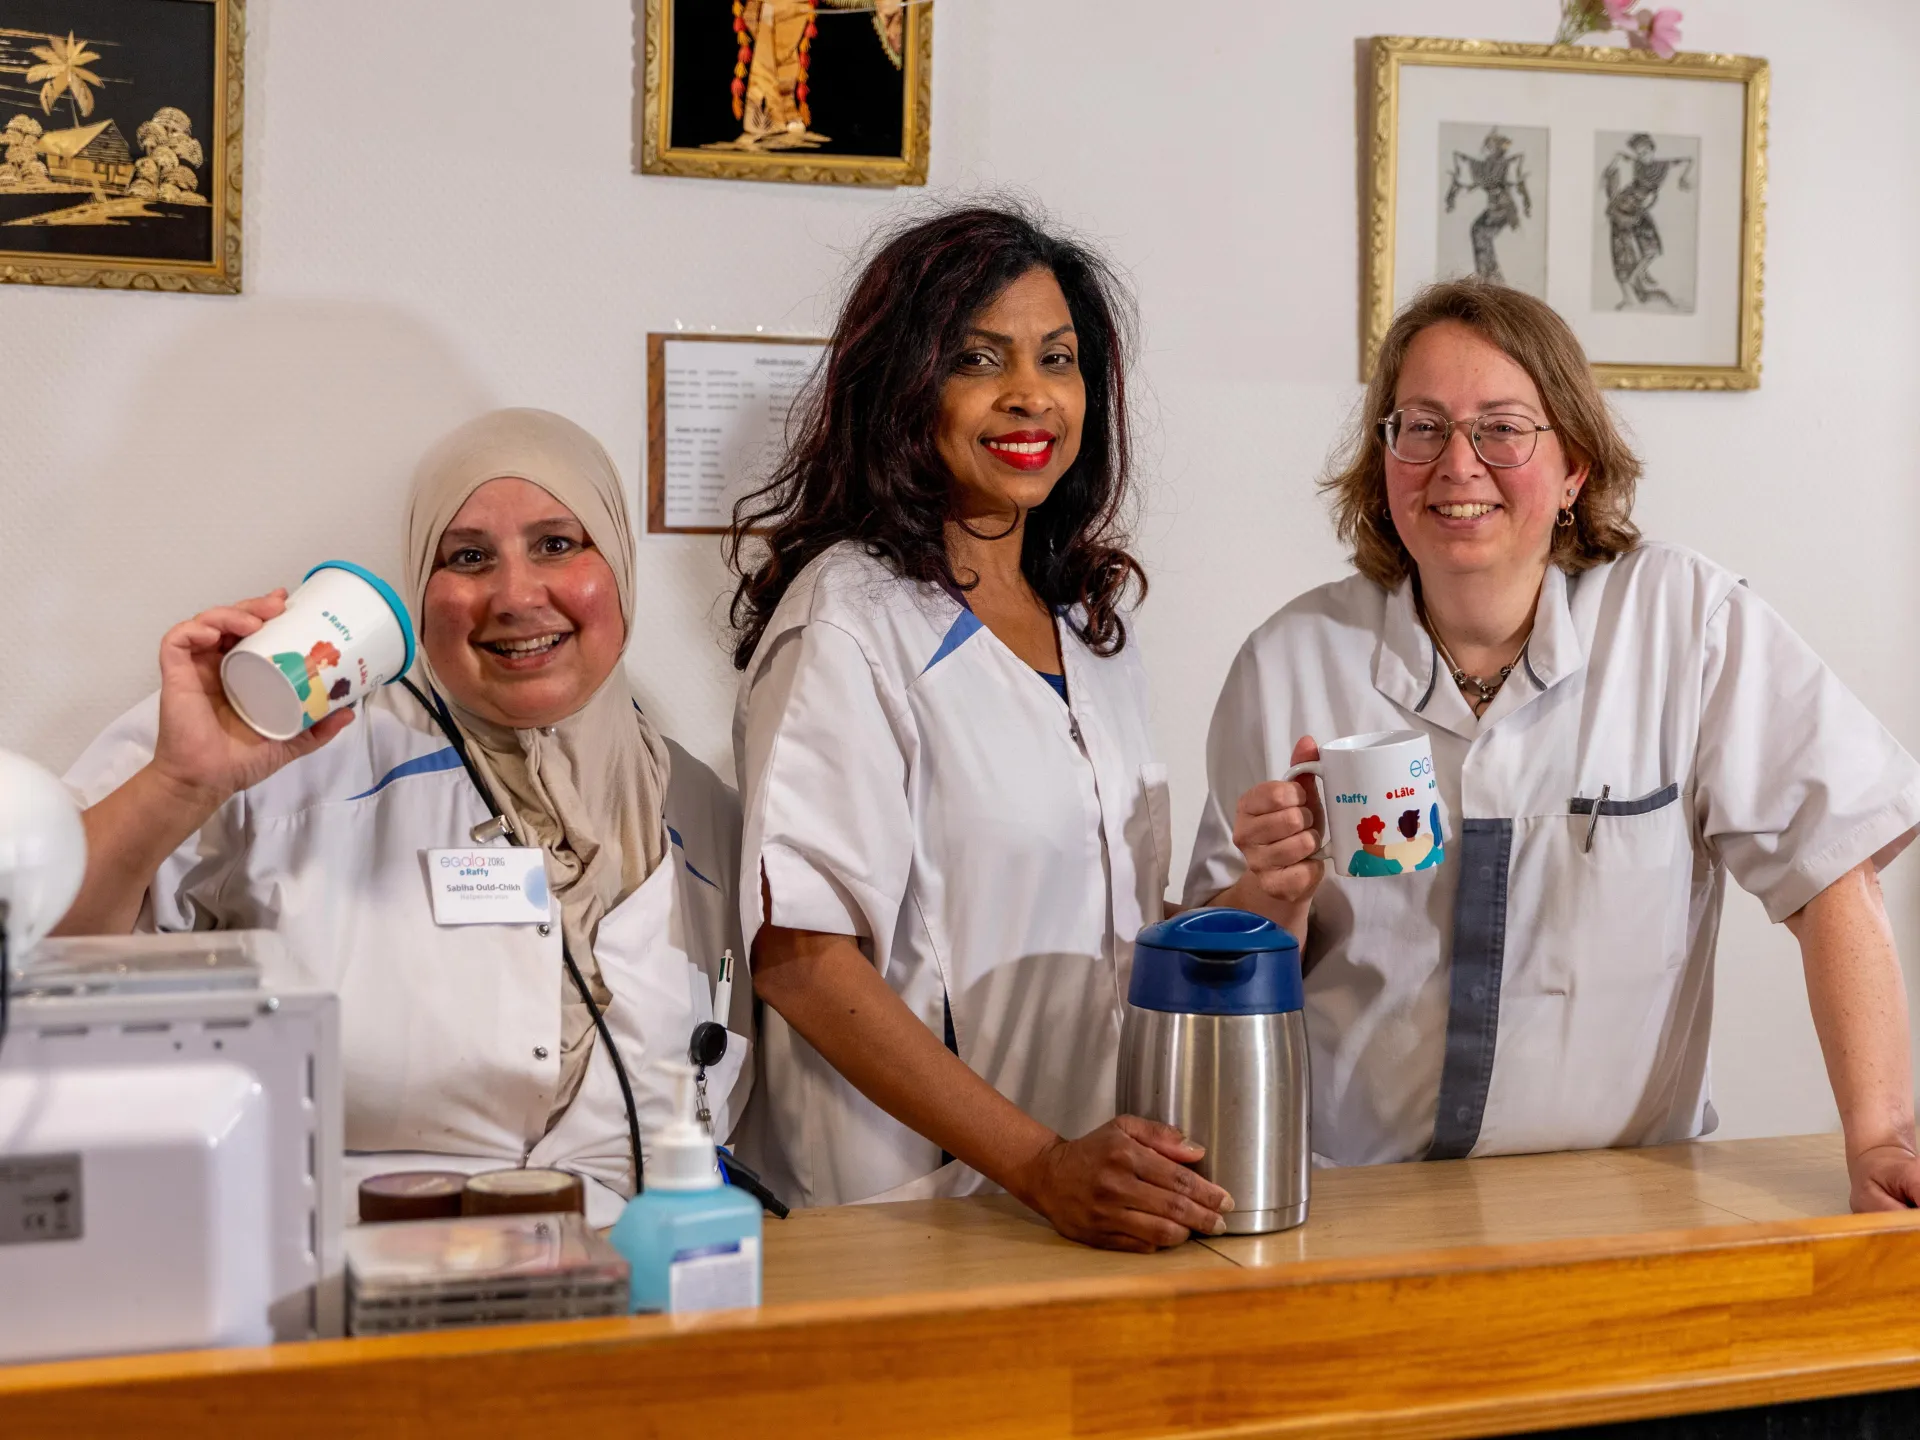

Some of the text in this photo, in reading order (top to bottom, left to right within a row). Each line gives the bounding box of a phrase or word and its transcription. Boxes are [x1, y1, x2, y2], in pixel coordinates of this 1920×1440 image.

[329, 615, 353, 641] Raffy
[1394, 786, 1415, 799] Lâle
[1341, 793, 1368, 805] Raffy
[466, 868, 489, 877] Raffy
[446, 883, 521, 892] Sabiha Ould-Chikh
